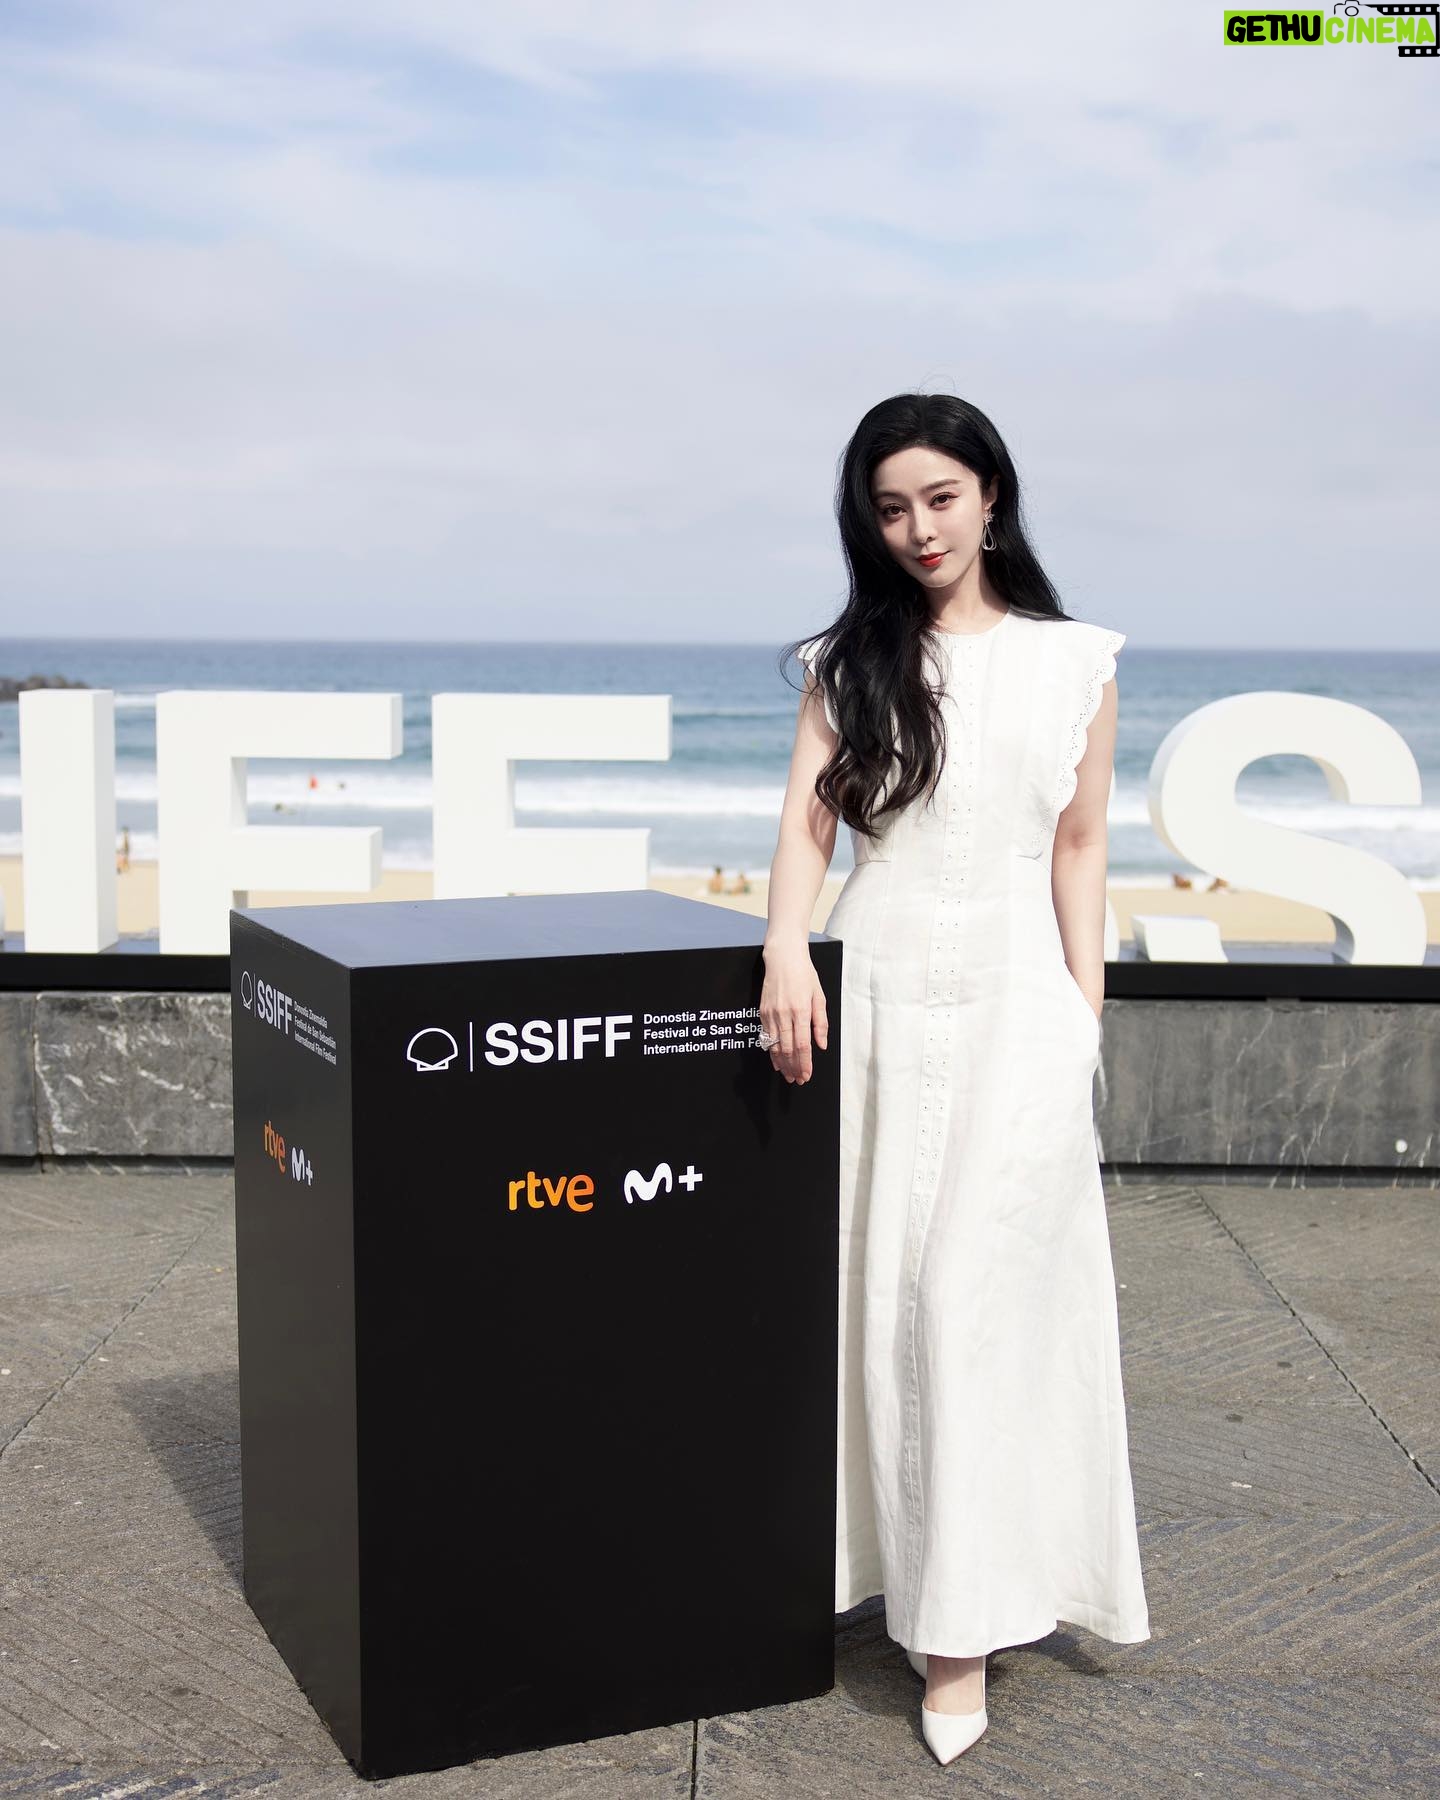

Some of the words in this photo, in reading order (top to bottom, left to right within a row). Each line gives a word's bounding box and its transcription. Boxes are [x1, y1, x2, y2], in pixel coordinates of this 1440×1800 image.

[0, 689, 672, 955] IFF
[257, 979, 293, 1035] SSIFF
[643, 1011, 697, 1025] Donostia
[484, 1014, 634, 1066] SSIFF
[643, 1026, 689, 1040] Festival
[691, 1026, 707, 1037] de
[709, 1024, 732, 1036] San
[735, 1022, 764, 1034] Seba
[643, 1040, 718, 1055] International
[720, 1038, 745, 1050] Film
[264, 1119, 286, 1174] rtve
[508, 1171, 595, 1213] rtve
